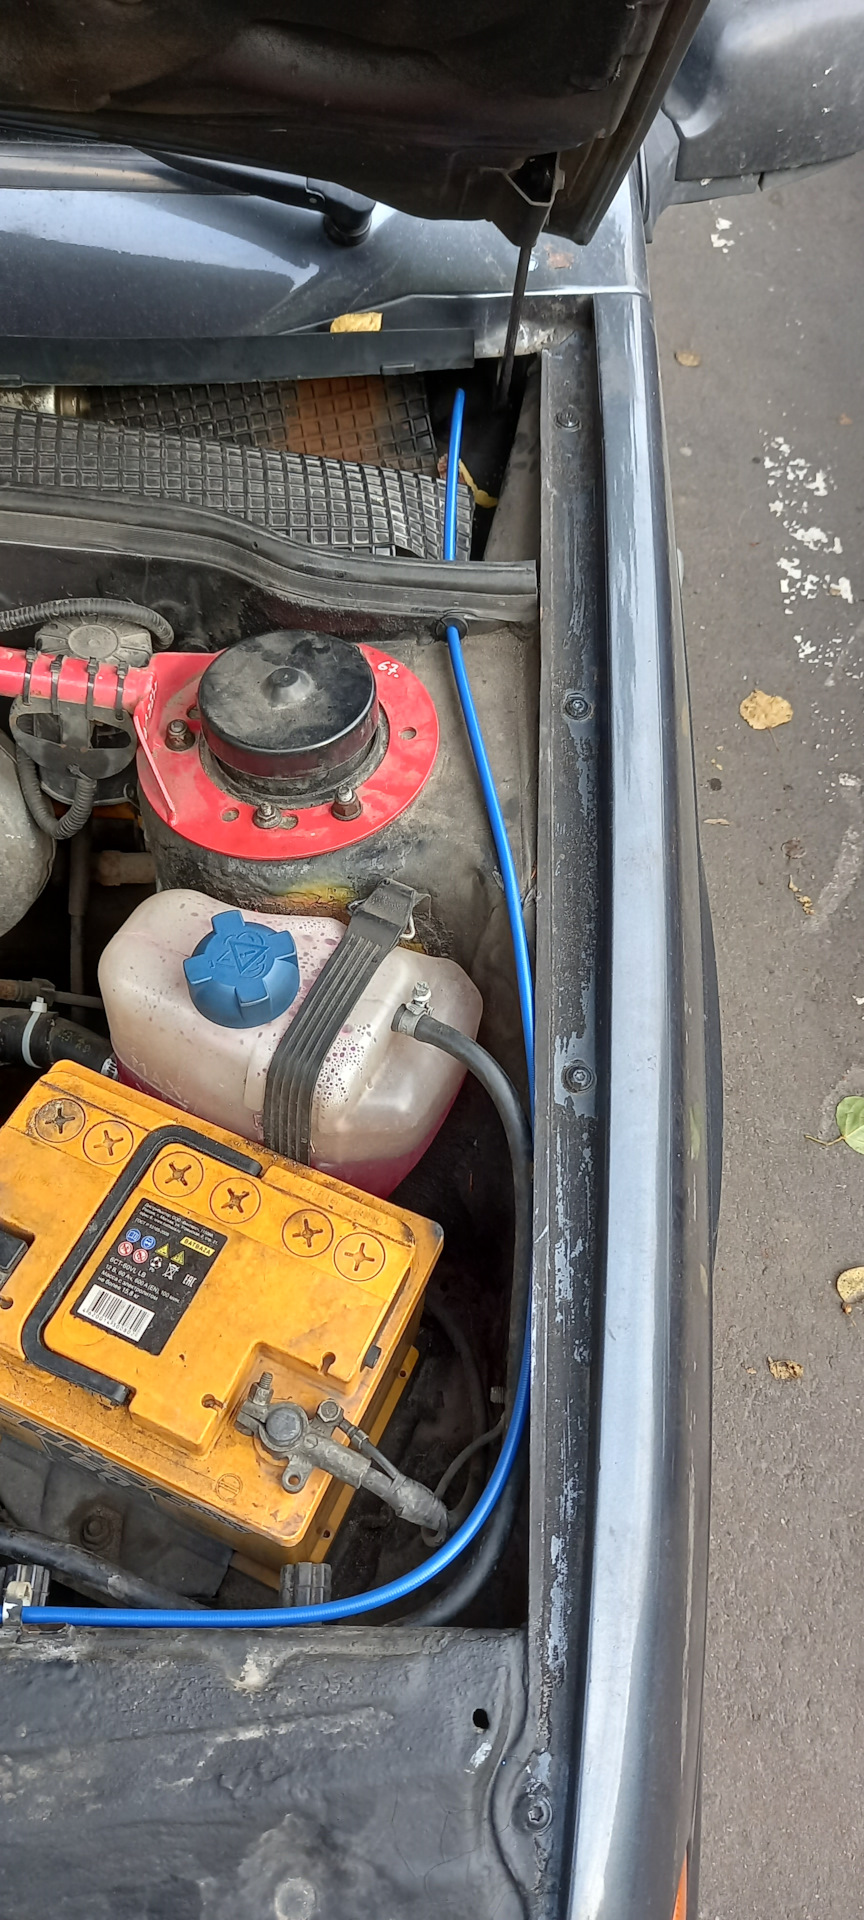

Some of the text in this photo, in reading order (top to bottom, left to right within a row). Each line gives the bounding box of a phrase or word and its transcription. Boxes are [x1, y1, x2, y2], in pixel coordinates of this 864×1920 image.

[183, 1238, 212, 1255] BATBAZA
[137, 1270, 147, 1278] LB
[100, 1270, 119, 1282] Масса
[120, 1280, 158, 1301] электролитом
[103, 1278, 122, 1290] более
[120, 1287, 134, 1297] 15,8
[133, 1277, 144, 1285] 600
[159, 1290, 169, 1298] 100
